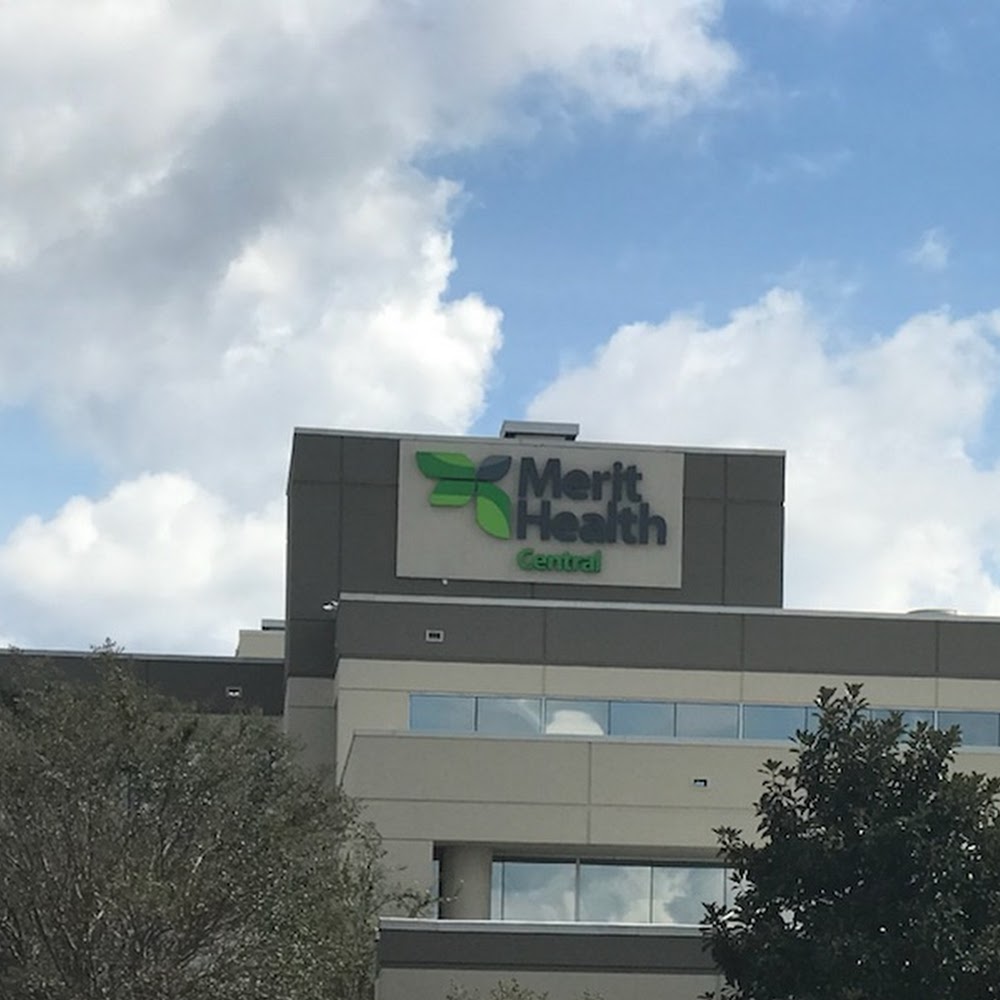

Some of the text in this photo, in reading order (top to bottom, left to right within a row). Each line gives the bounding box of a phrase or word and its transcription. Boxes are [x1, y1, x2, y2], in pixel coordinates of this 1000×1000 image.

[517, 457, 643, 502] Merit
[516, 500, 667, 545] Health
[516, 548, 602, 573] Central
